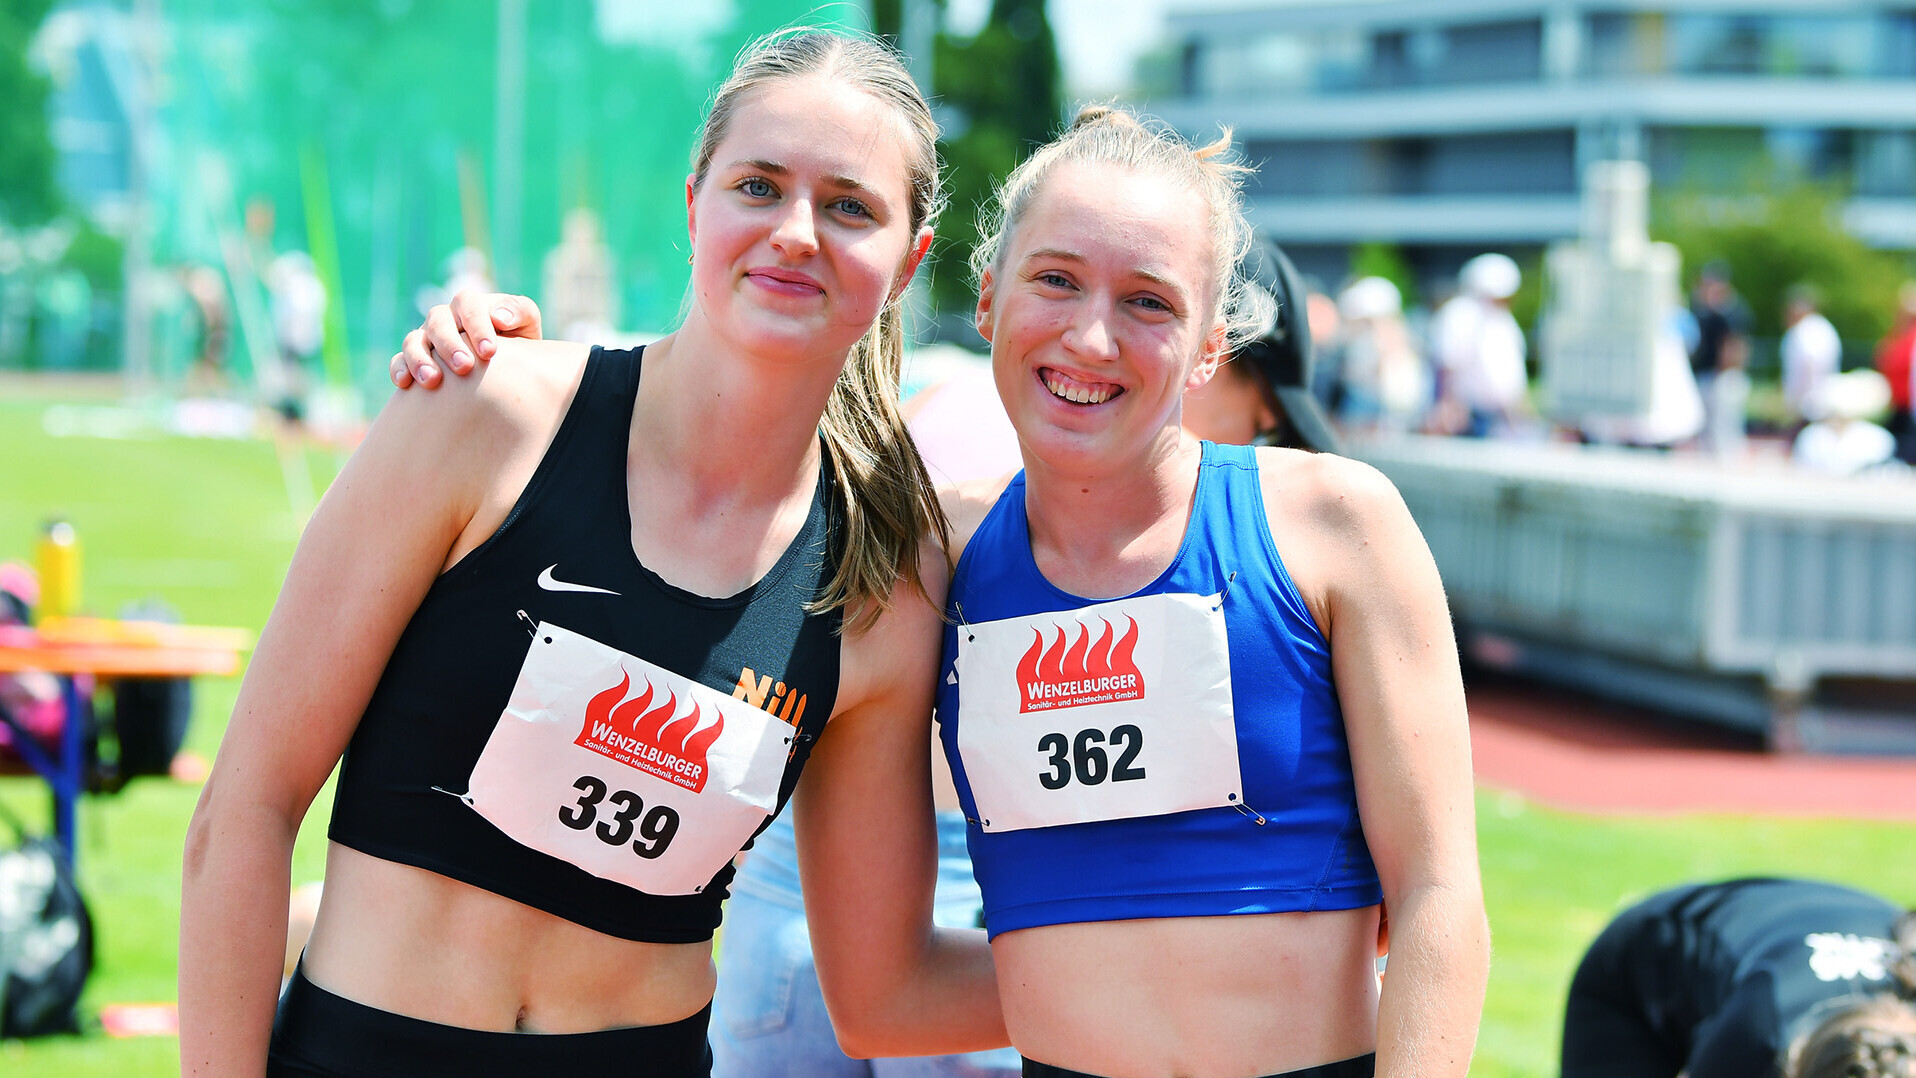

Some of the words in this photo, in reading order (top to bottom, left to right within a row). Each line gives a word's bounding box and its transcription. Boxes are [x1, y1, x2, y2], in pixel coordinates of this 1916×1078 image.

[1027, 673, 1137, 700] WENZELBURGER
[1027, 700, 1056, 710] Sanitär-
[1058, 697, 1072, 707] und
[1073, 692, 1113, 705] Heiztechnik
[1114, 690, 1138, 700] GmbH
[583, 738, 614, 754] Sanitär-
[615, 752, 631, 763] und
[631, 758, 673, 779] Heiztechnik
[673, 775, 697, 790] GmbH
[591, 719, 702, 780] WENZELBURGER
[1038, 724, 1146, 790] 362
[558, 776, 680, 859] 339
